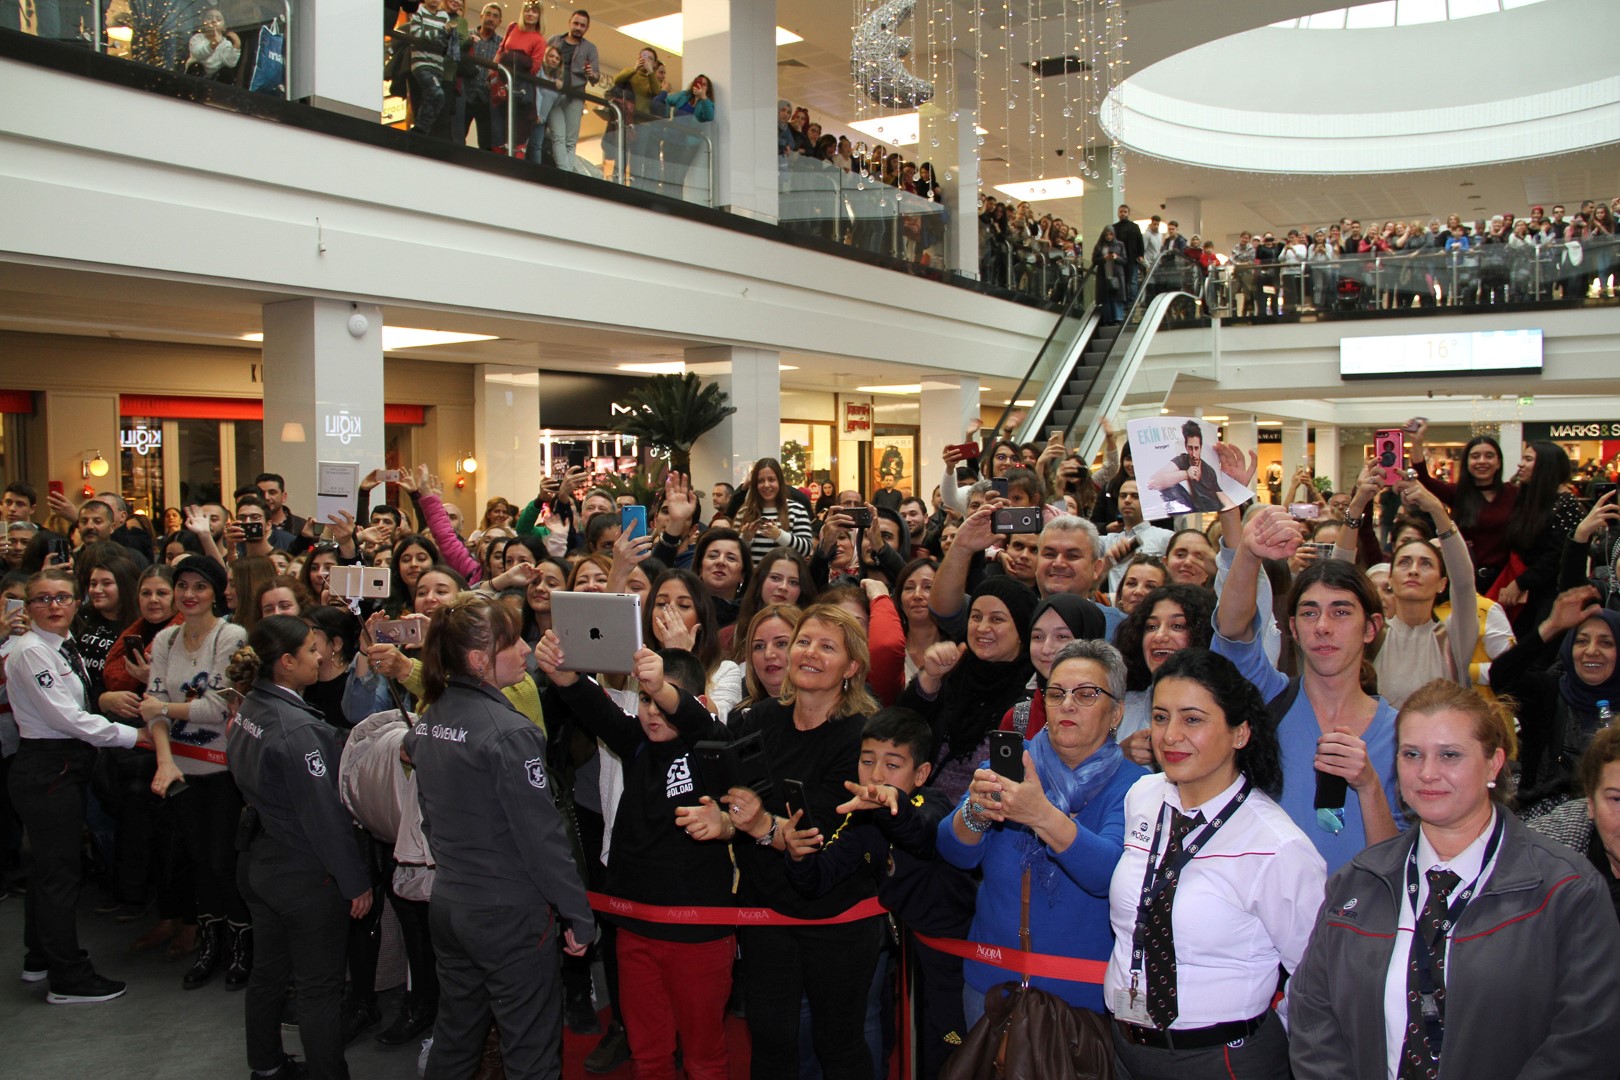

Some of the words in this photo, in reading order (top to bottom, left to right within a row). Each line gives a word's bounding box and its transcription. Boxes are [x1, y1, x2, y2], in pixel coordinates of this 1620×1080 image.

[1425, 338, 1458, 359] 16°
[98, 638, 114, 650] OF
[432, 724, 468, 742] GÜVENLİK
[667, 908, 698, 919] AGORA
[737, 909, 769, 920] AGORA
[976, 943, 1002, 960] AGORA
